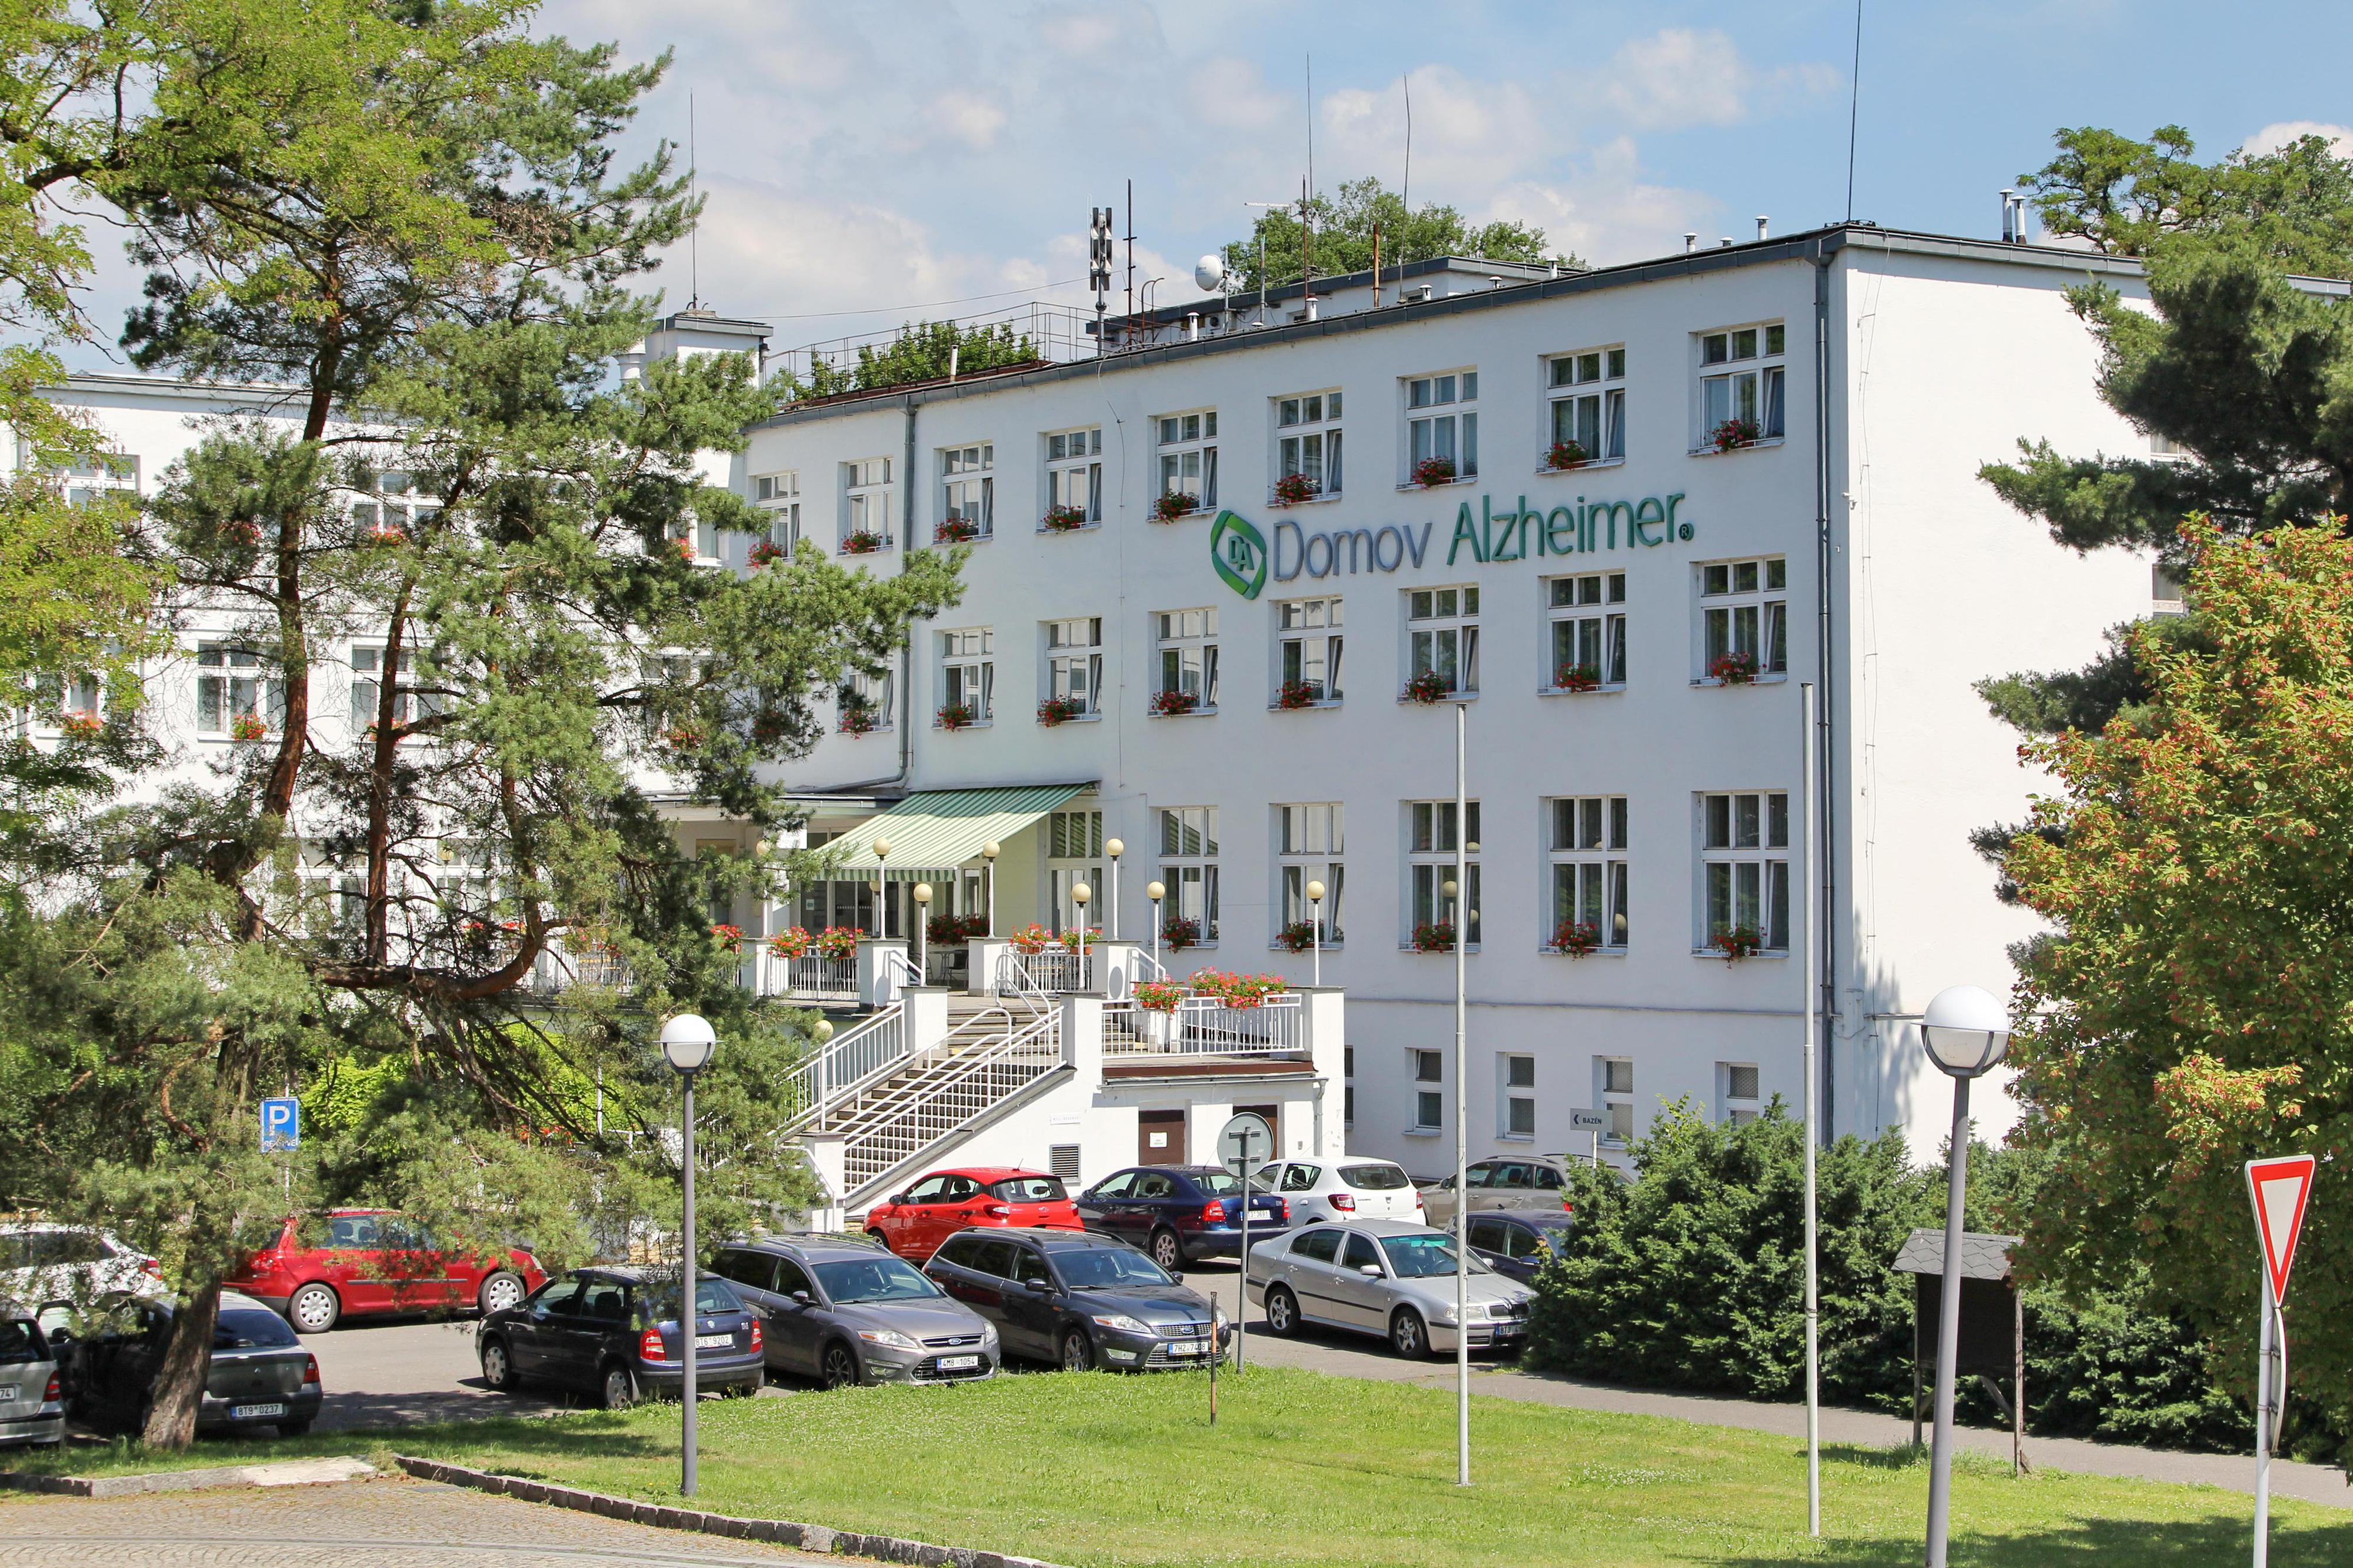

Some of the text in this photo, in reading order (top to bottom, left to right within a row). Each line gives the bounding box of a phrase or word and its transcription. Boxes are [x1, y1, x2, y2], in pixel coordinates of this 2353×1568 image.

[1274, 521, 1432, 581] Domov
[269, 1106, 290, 1136] P
[1583, 1116, 1602, 1125] BAZÉN
[713, 1336, 729, 1345] 9202
[1174, 1343, 1186, 1352] 7H2
[943, 1357, 975, 1367] 4M8 1054
[238, 1404, 279, 1415] 8T9 0237
